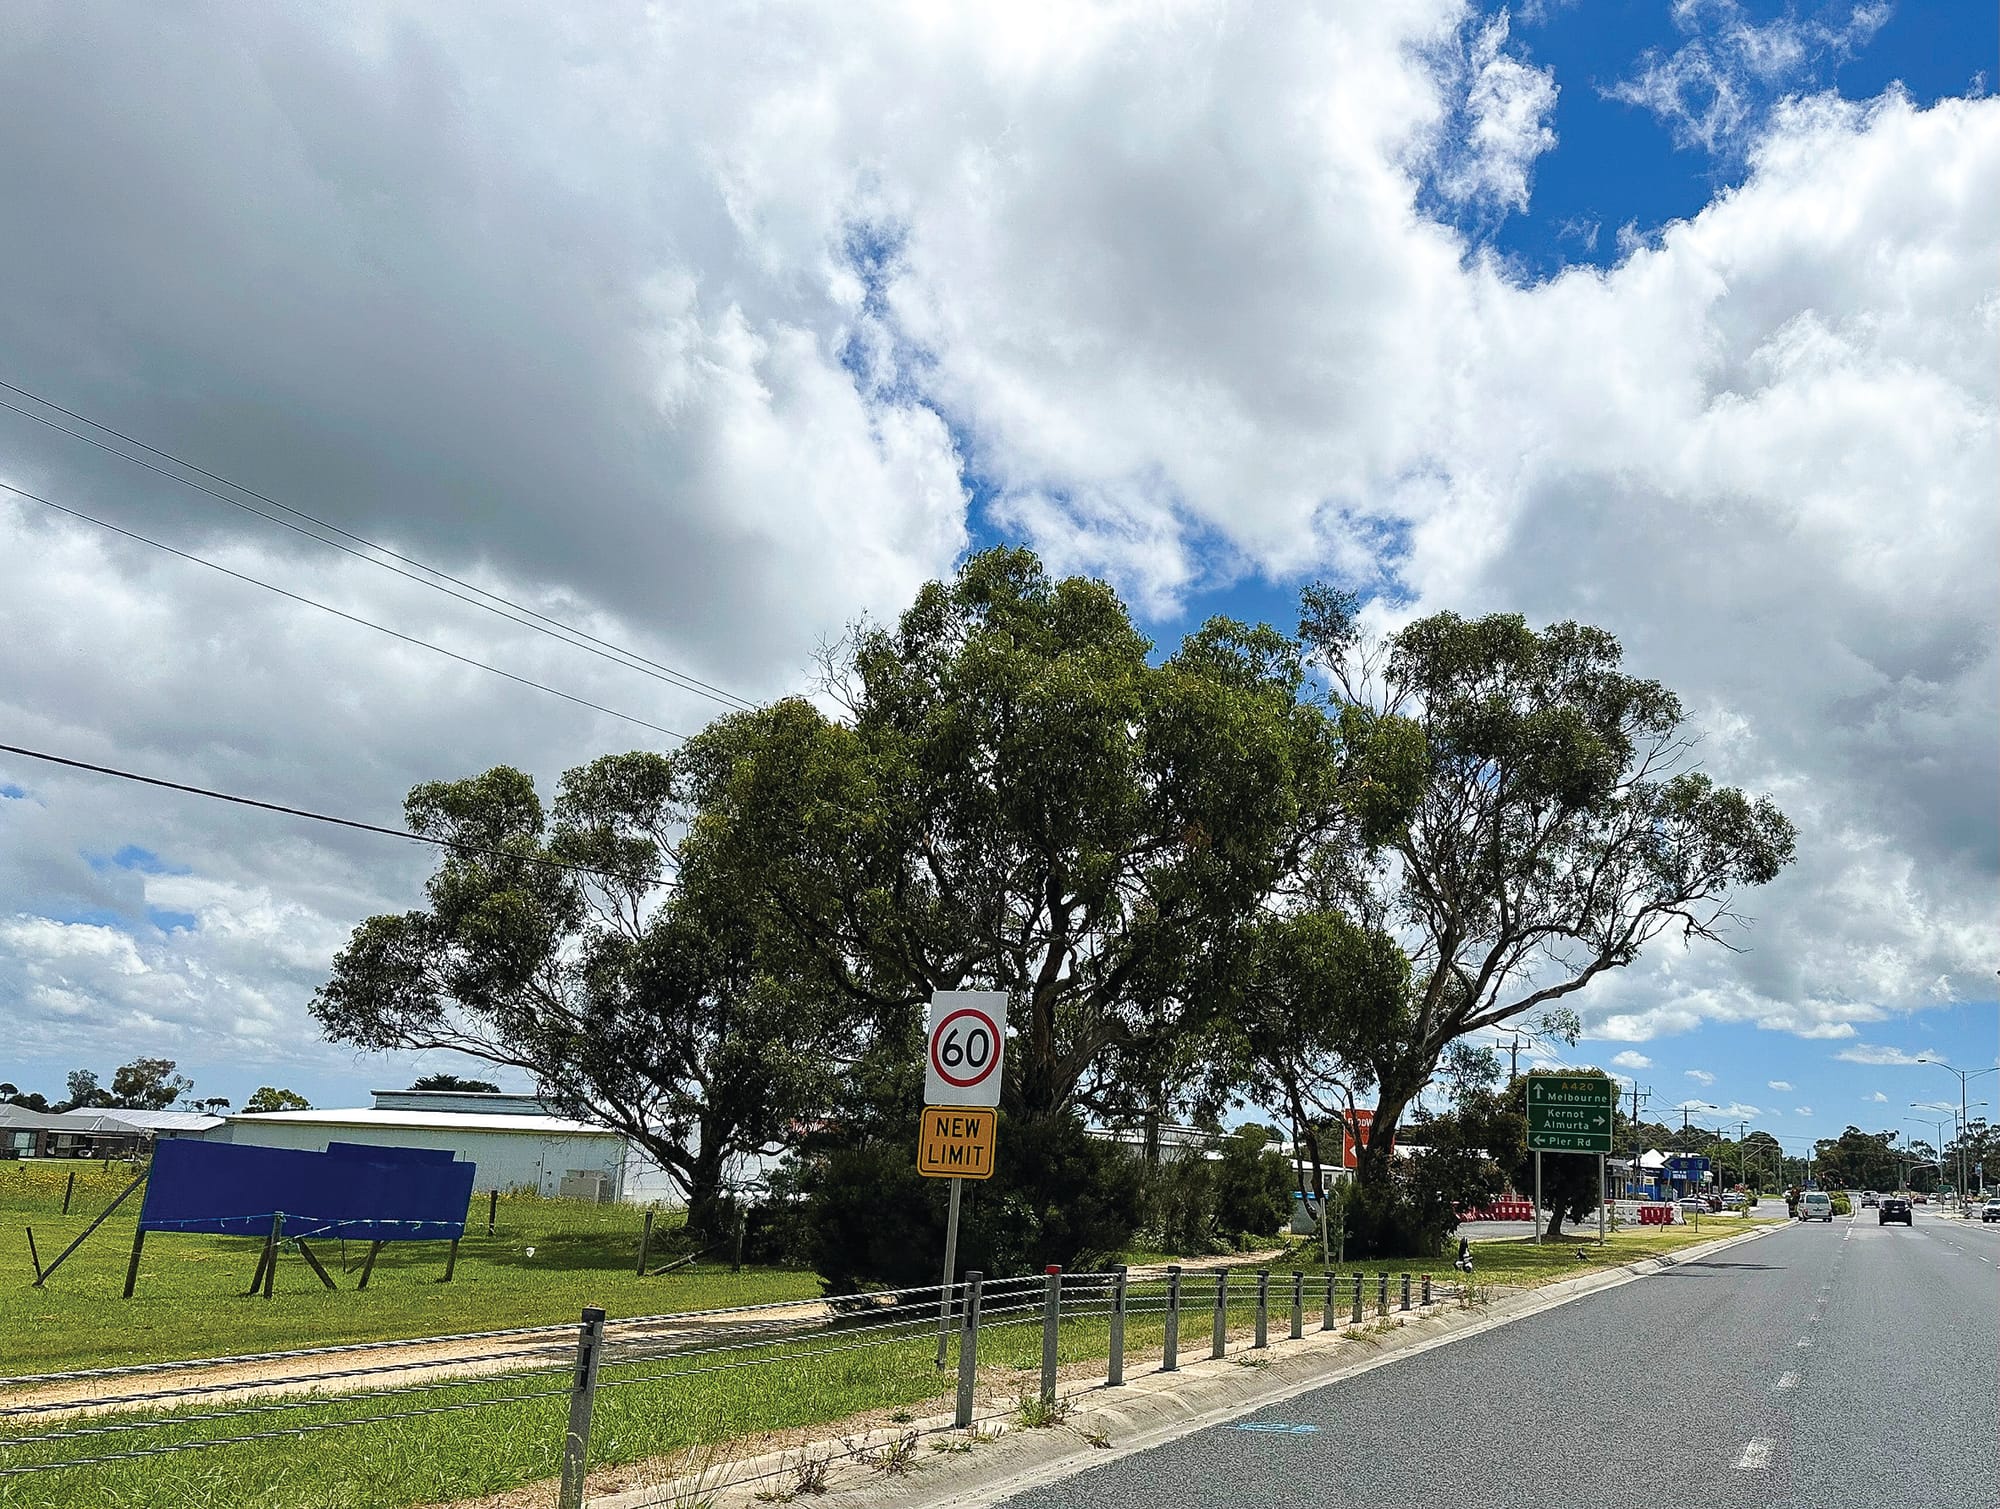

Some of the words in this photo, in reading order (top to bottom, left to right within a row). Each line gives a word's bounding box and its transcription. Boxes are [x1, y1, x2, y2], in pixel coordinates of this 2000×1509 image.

[942, 1028, 990, 1067] 60
[1561, 1082, 1594, 1091] A420
[1547, 1092, 1608, 1103] Melbourne
[1547, 1109, 1585, 1118] Kernot
[936, 1117, 981, 1139] NEW
[1543, 1120, 1590, 1130] Almurta
[1549, 1136, 1572, 1146] Pier
[1577, 1138, 1591, 1147] Rd
[928, 1144, 985, 1167] LIMIT
